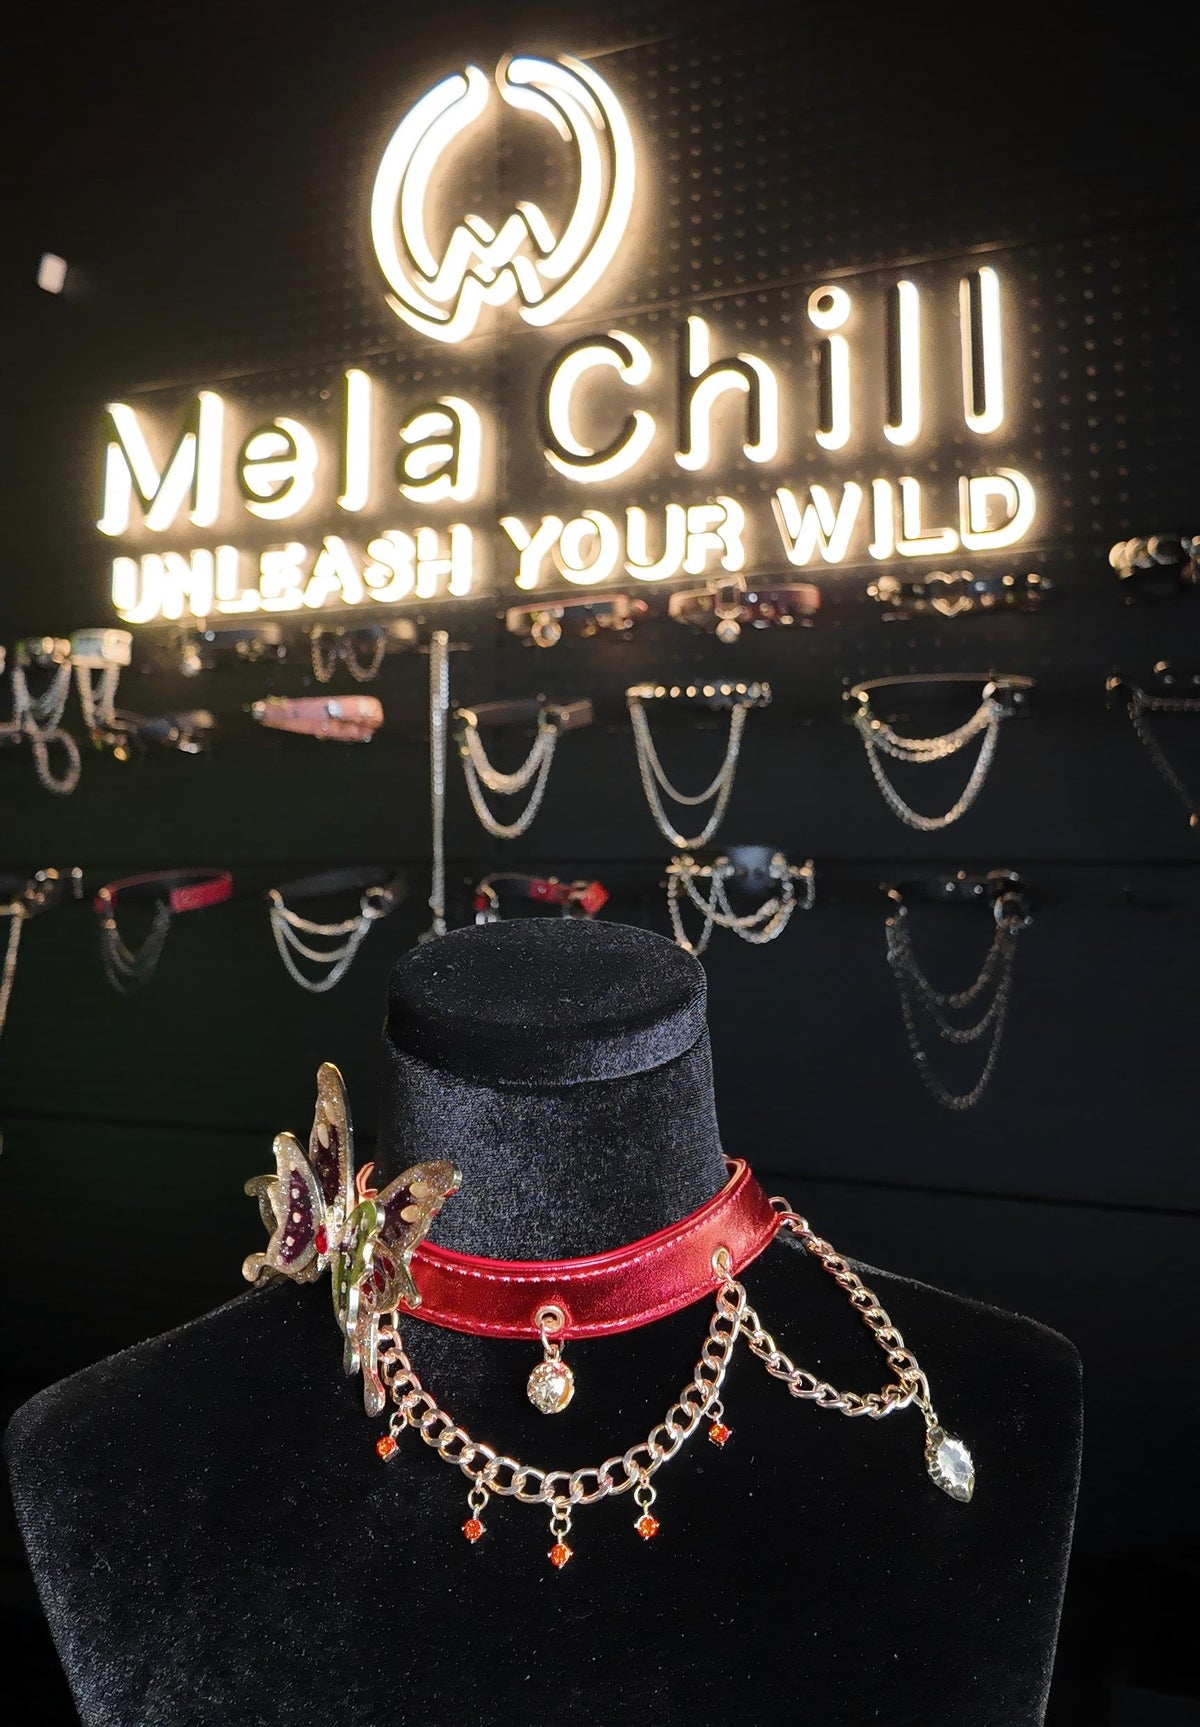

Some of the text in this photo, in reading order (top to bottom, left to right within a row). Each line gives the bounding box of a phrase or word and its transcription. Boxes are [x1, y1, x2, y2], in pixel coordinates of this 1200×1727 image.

[97, 266, 1004, 536] Mela Chill
[112, 467, 1037, 625] UNLEASH YOUR WILD
